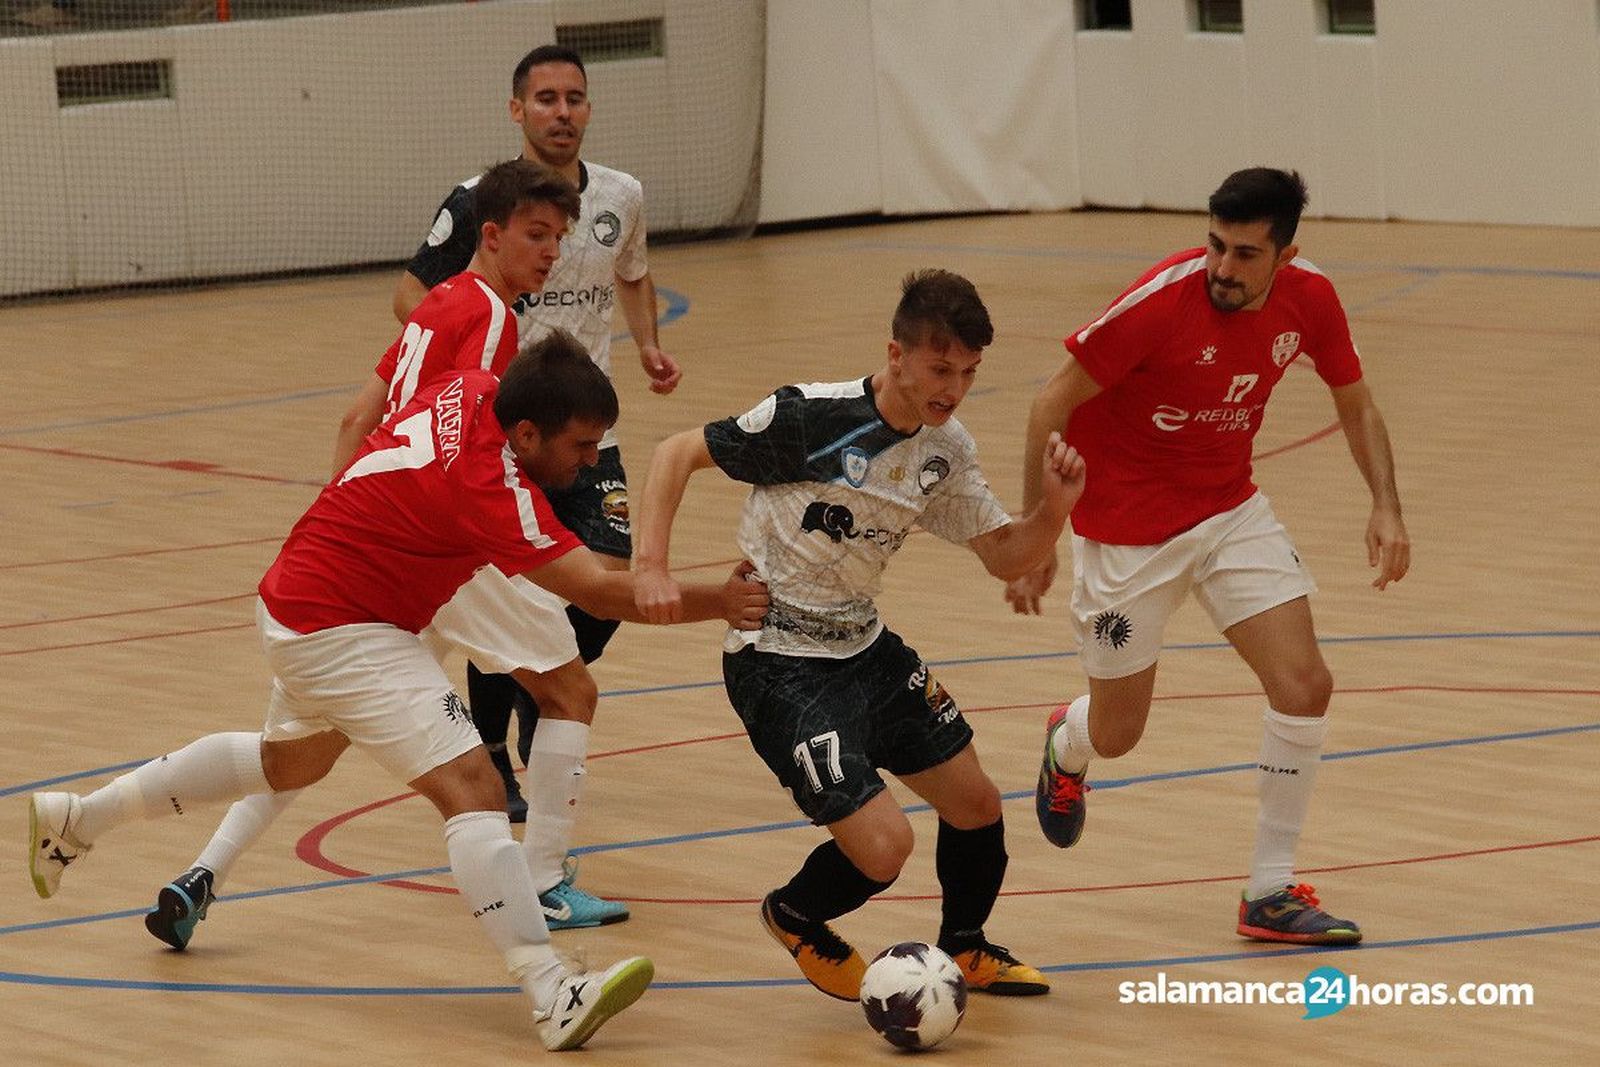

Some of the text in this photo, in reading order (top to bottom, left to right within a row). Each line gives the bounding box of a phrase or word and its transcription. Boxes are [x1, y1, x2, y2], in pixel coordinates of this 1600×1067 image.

[1222, 373, 1259, 403] 17
[337, 408, 436, 487] 7
[436, 376, 463, 472] VALTRA
[792, 730, 845, 793] 17
